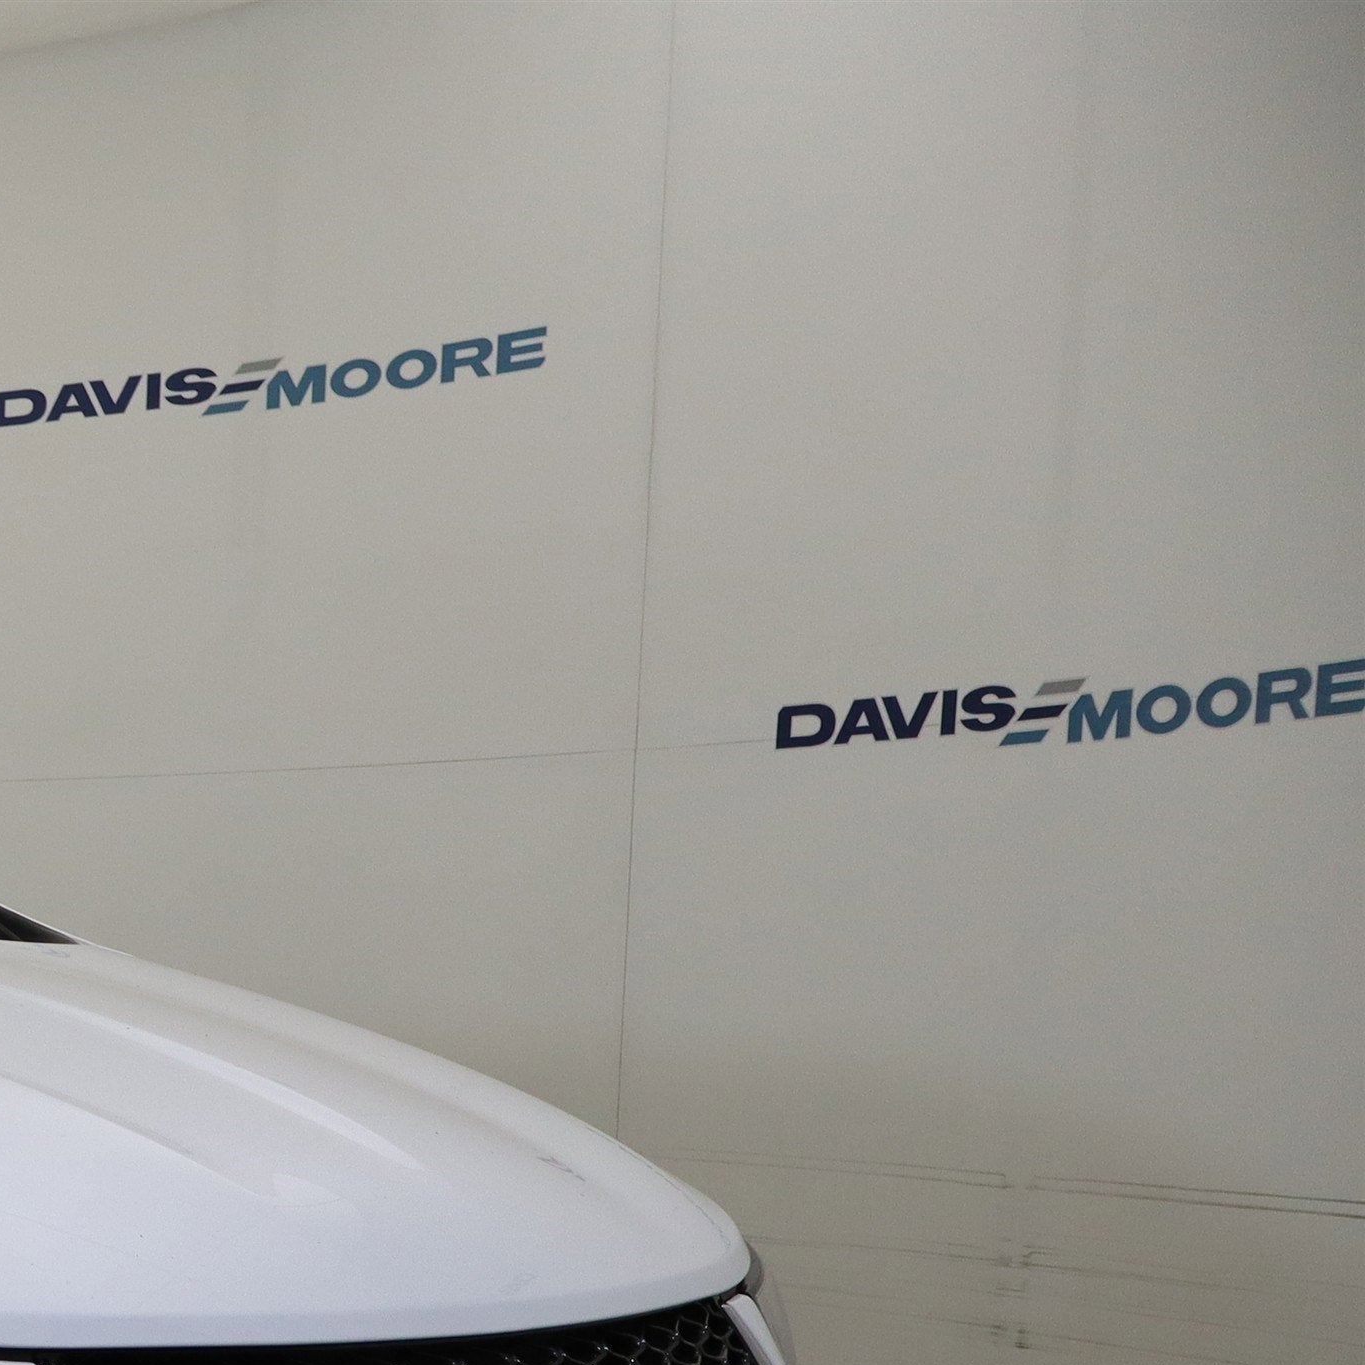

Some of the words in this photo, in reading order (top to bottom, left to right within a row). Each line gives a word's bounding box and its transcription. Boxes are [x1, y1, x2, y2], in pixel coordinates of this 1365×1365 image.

[265, 325, 549, 411] MOORE
[774, 684, 1018, 750] DAVIS
[1065, 658, 1365, 746] MOORE
